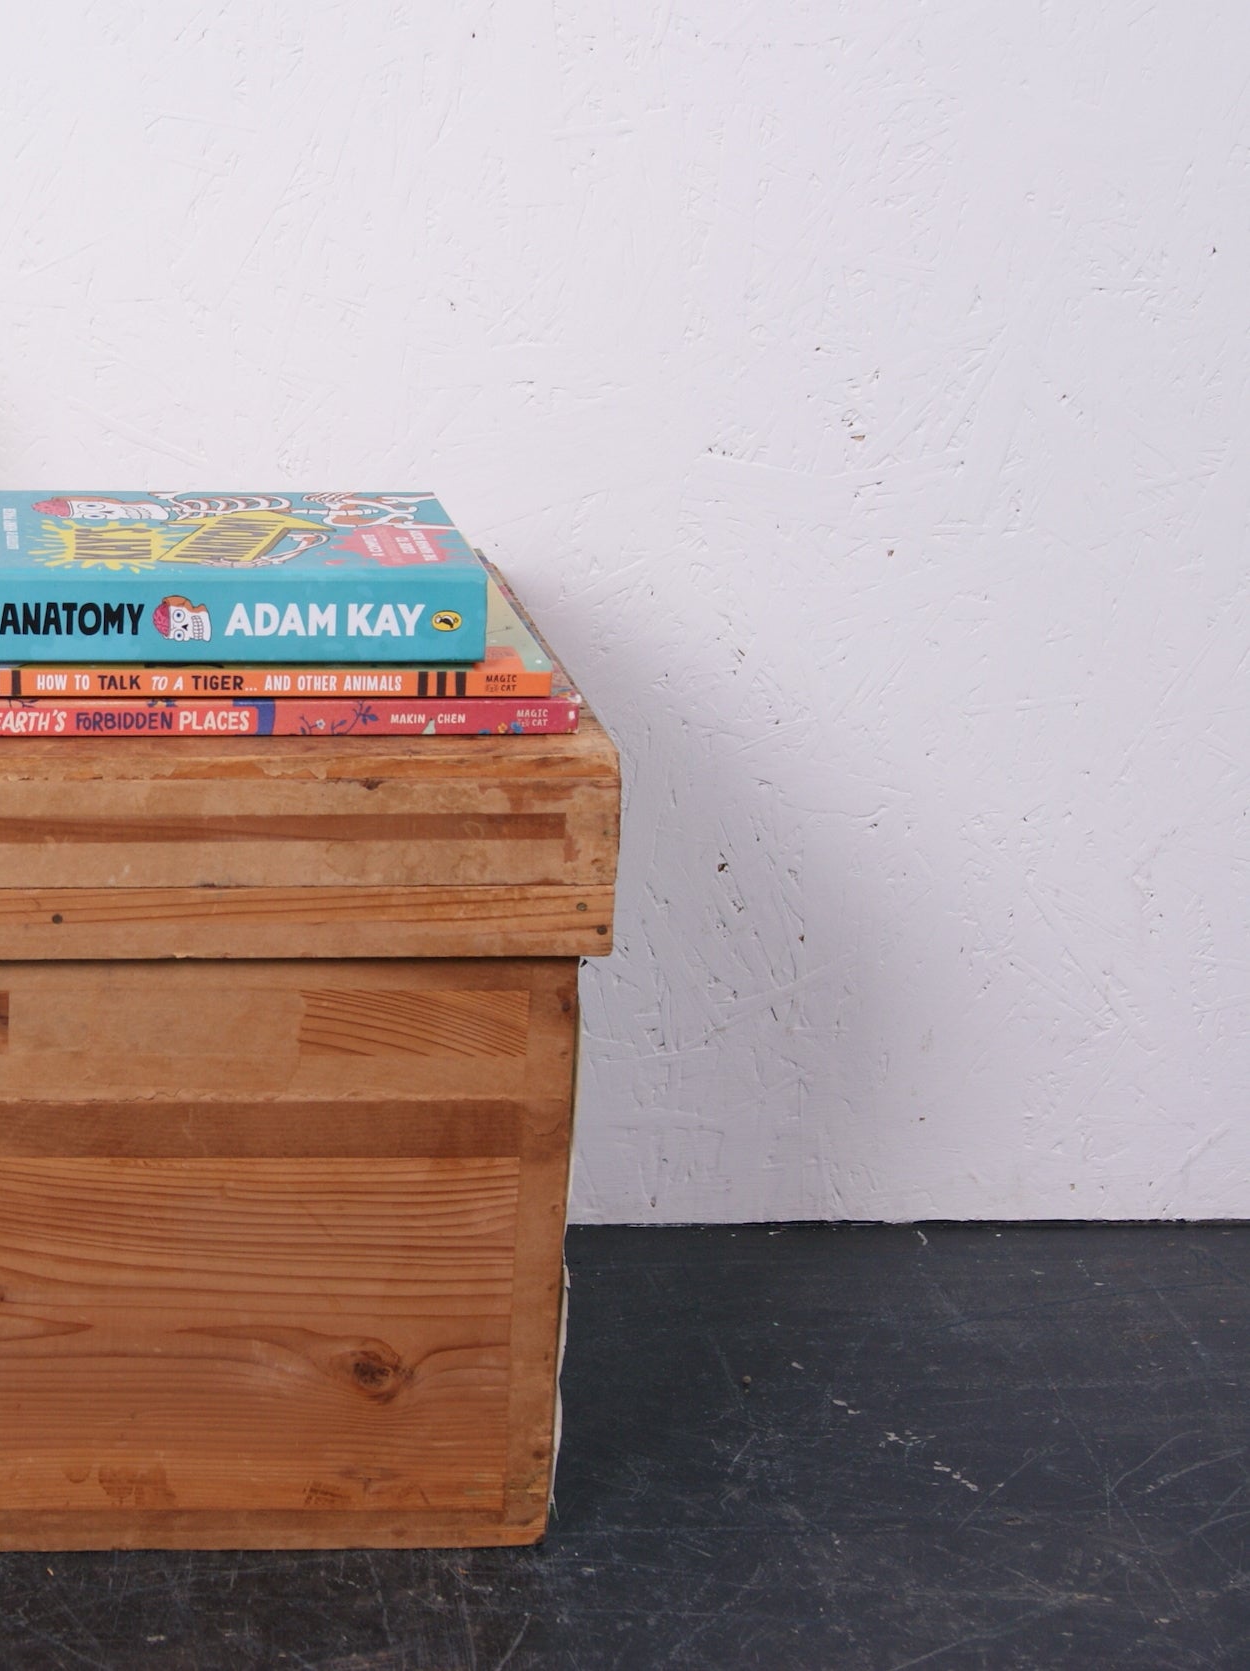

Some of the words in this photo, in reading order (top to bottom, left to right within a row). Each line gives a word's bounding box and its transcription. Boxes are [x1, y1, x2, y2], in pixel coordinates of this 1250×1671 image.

[74, 528, 152, 560] KAY'S
[174, 517, 286, 562] ANATOMY
[0, 602, 145, 636] ANATOMY
[224, 603, 338, 637] ADAM
[347, 603, 426, 637] KAY
[37, 674, 68, 691] HOW
[74, 674, 91, 691] TO
[98, 675, 141, 691] TALK
[151, 676, 169, 691] TO
[173, 676, 184, 691] A
[264, 675, 292, 691] AND
[297, 675, 338, 692] OTHER
[343, 675, 402, 692] ANIMALS
[485, 674, 518, 683] MAGIC
[500, 684, 517, 692] CAT
[179, 711, 250, 731] PLACES
[390, 713, 426, 724] MAKIN
[437, 713, 466, 724] CHEN
[516, 708, 549, 718] MAGIC
[532, 719, 549, 727] CAT
